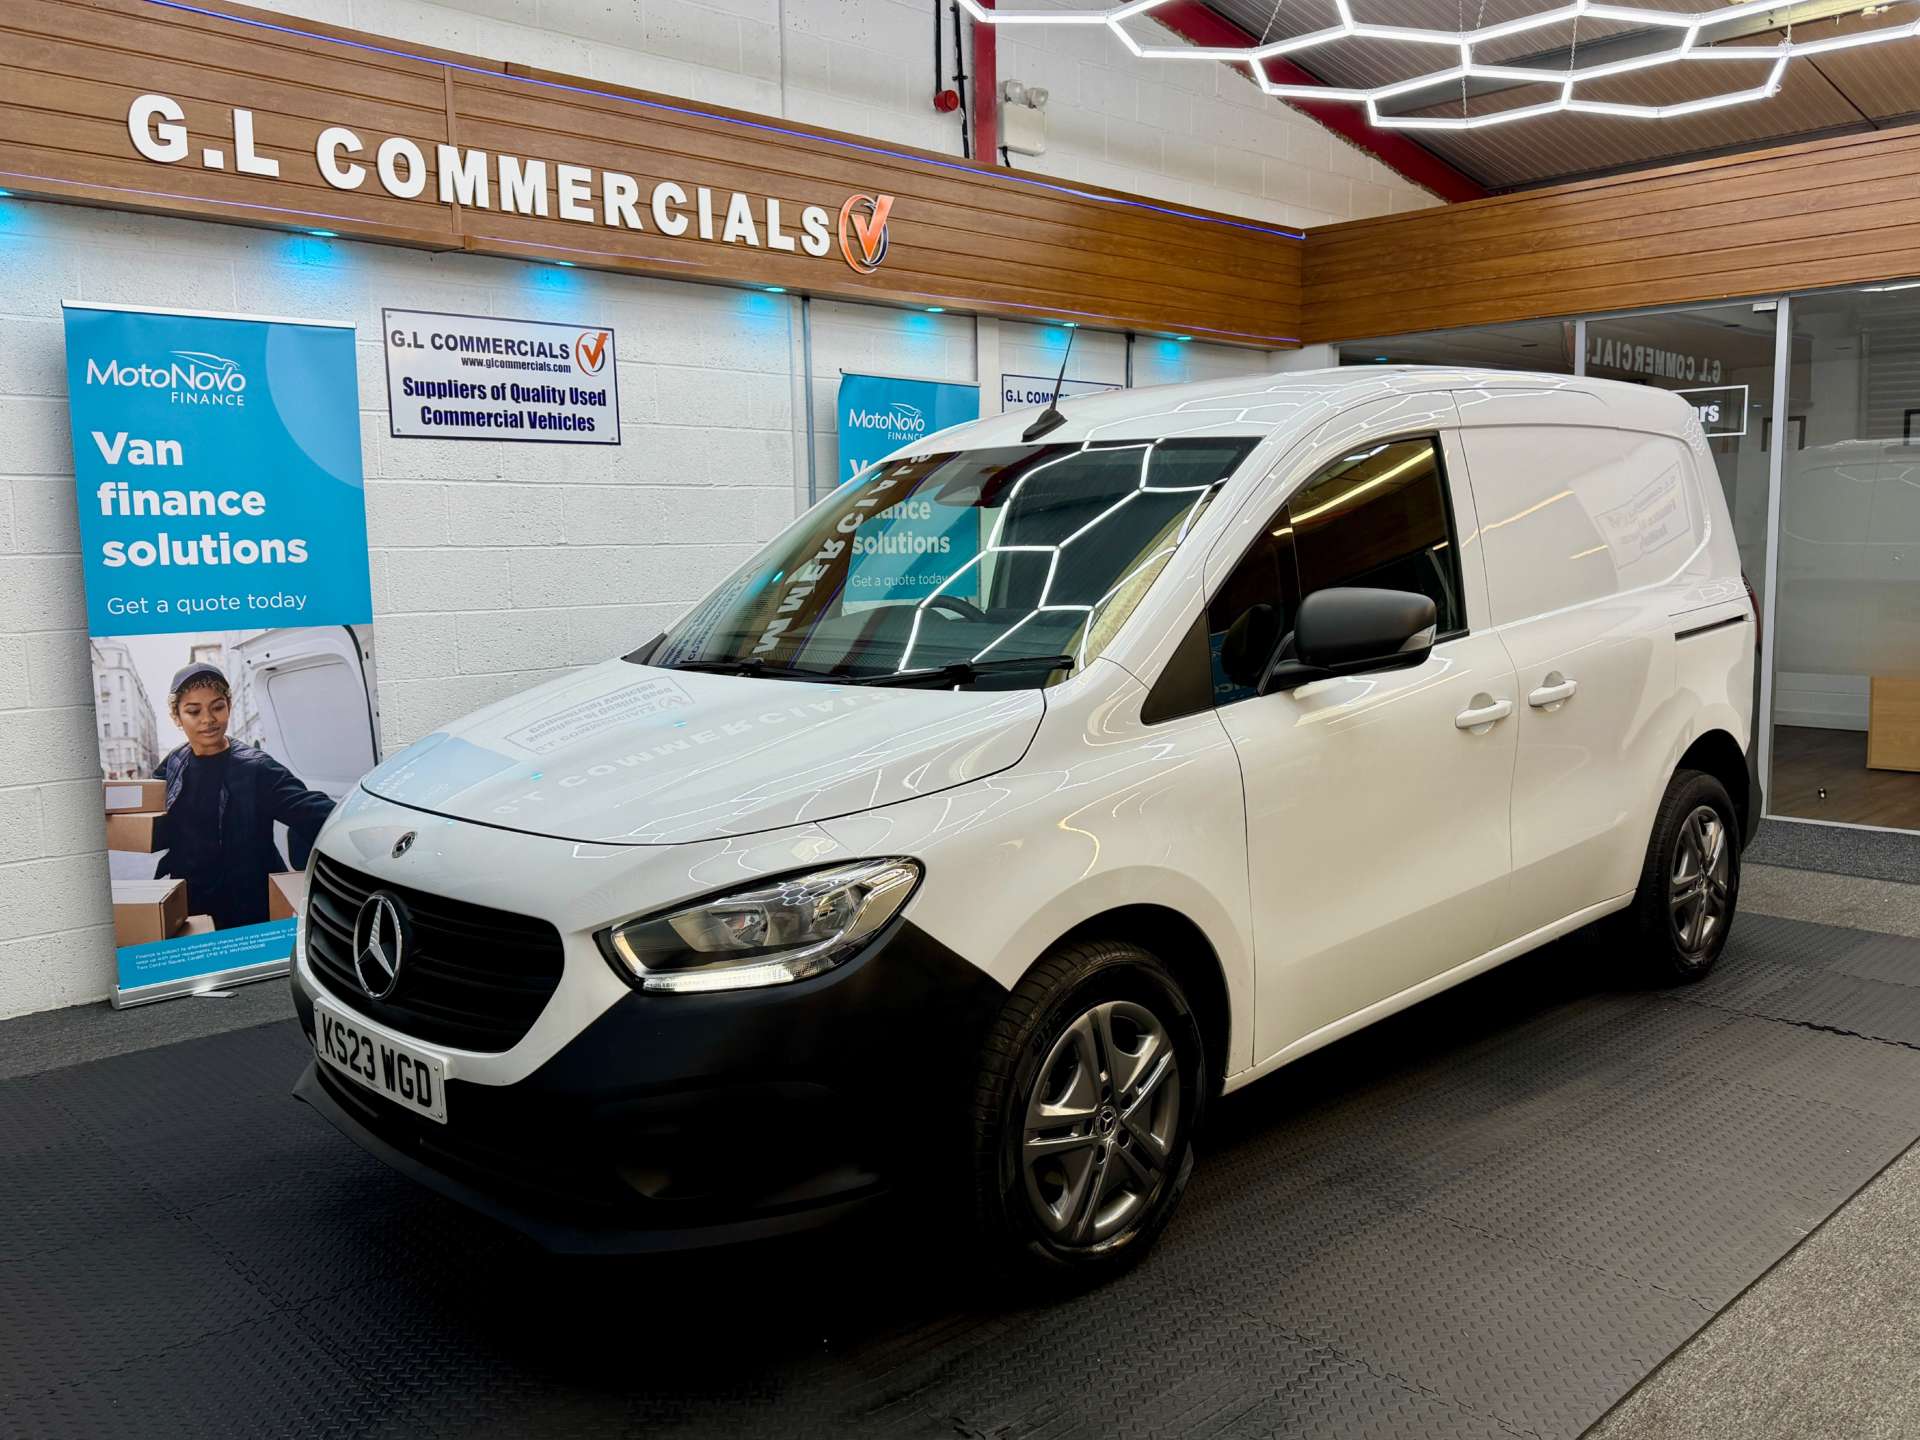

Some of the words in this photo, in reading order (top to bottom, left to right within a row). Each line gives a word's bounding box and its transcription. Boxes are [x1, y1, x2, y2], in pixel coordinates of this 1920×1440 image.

[127, 94, 280, 178] G.L
[316, 126, 831, 258] COMMERCIALS
[391, 329, 425, 349] G.L
[431, 333, 570, 360] COMMERCIALS
[86, 357, 246, 393] MotoNovo
[460, 356, 571, 374] www.glcommercials.com
[171, 391, 245, 407] FINANCE
[403, 376, 487, 401] Suppliers
[491, 382, 507, 401] of
[510, 384, 565, 407] Quality
[569, 388, 606, 407] Used
[421, 406, 523, 430] Commercial
[528, 411, 595, 432] Vehicles
[848, 408, 925, 432] MotoNovo
[91, 431, 184, 466] Van
[97, 481, 266, 517] finance
[102, 531, 309, 568] solutions
[851, 530, 951, 555] solutions
[852, 575, 872, 588] Get
[874, 576, 881, 586] a
[884, 573, 918, 591] quote
[107, 596, 149, 616] Get
[156, 599, 169, 614] a
[176, 593, 241, 616] quote
[247, 591, 307, 612] today
[322, 1012, 377, 1082] KS23
[380, 1043, 432, 1108] WGD
